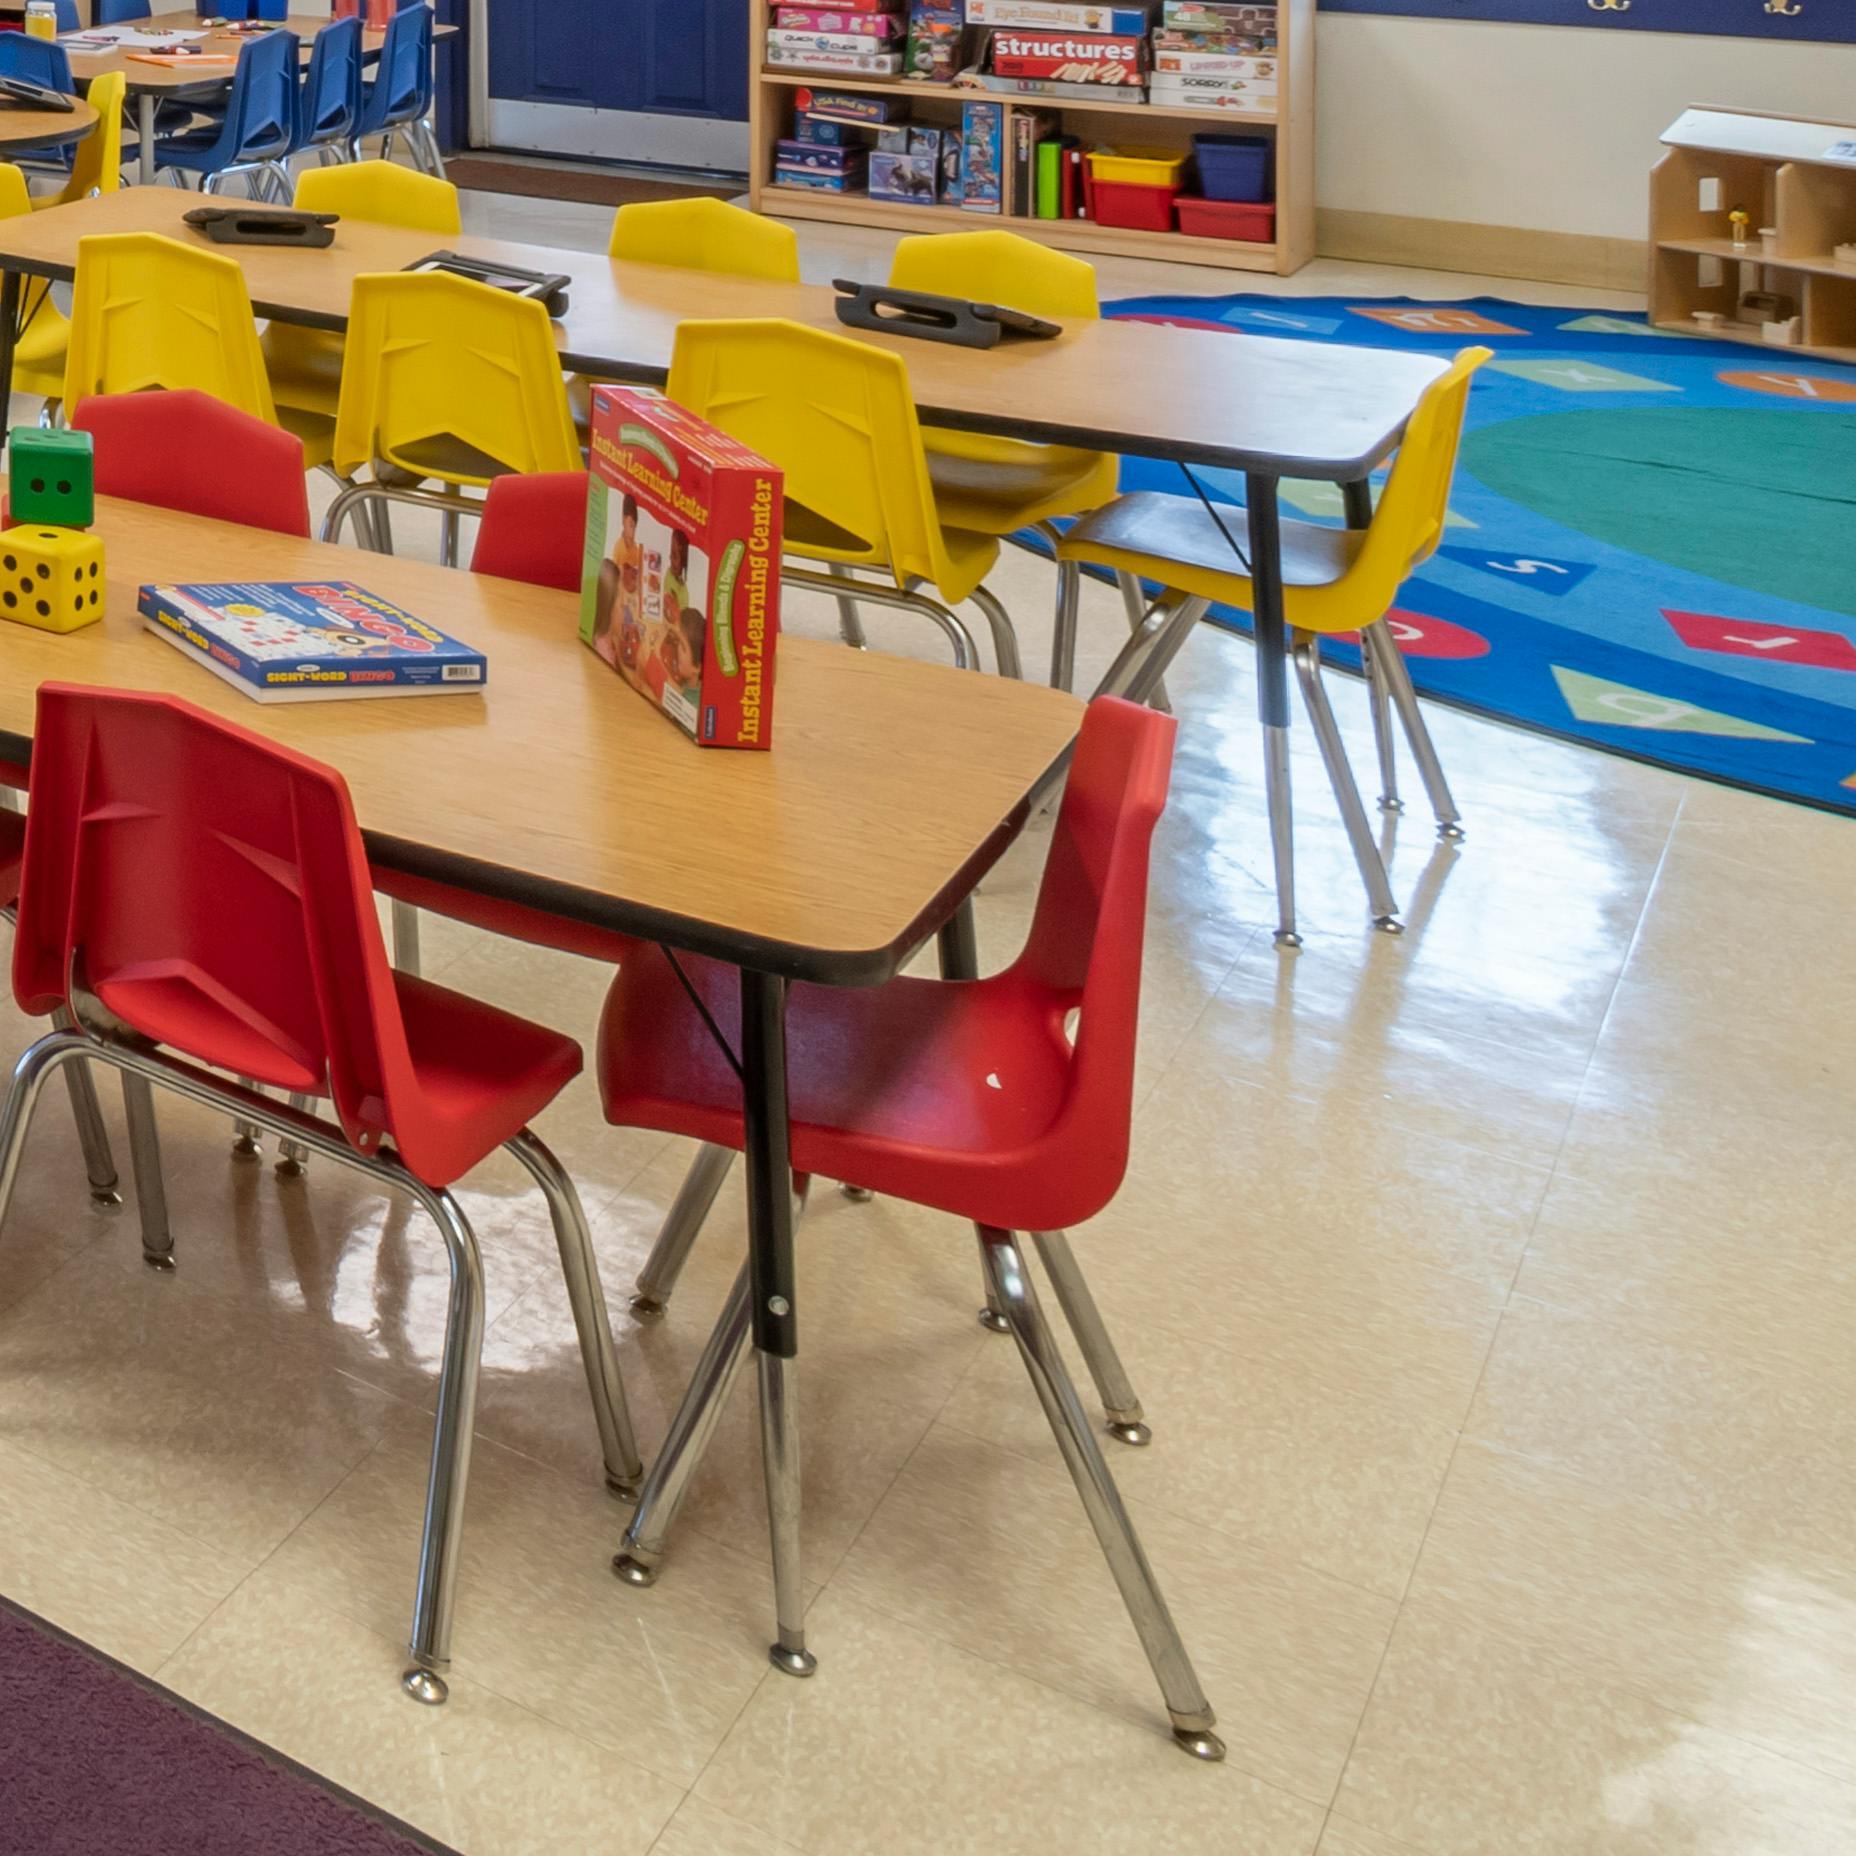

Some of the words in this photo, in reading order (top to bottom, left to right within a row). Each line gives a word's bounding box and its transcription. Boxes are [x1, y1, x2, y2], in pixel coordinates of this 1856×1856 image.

[995, 38, 1136, 60] structures
[748, 479, 773, 553] Center
[742, 555, 769, 657] Learning
[266, 671, 347, 683] SIGHT-WORD
[349, 670, 395, 682] BINGO
[718, 626, 736, 672] Beginning
[738, 660, 763, 743] Instant
